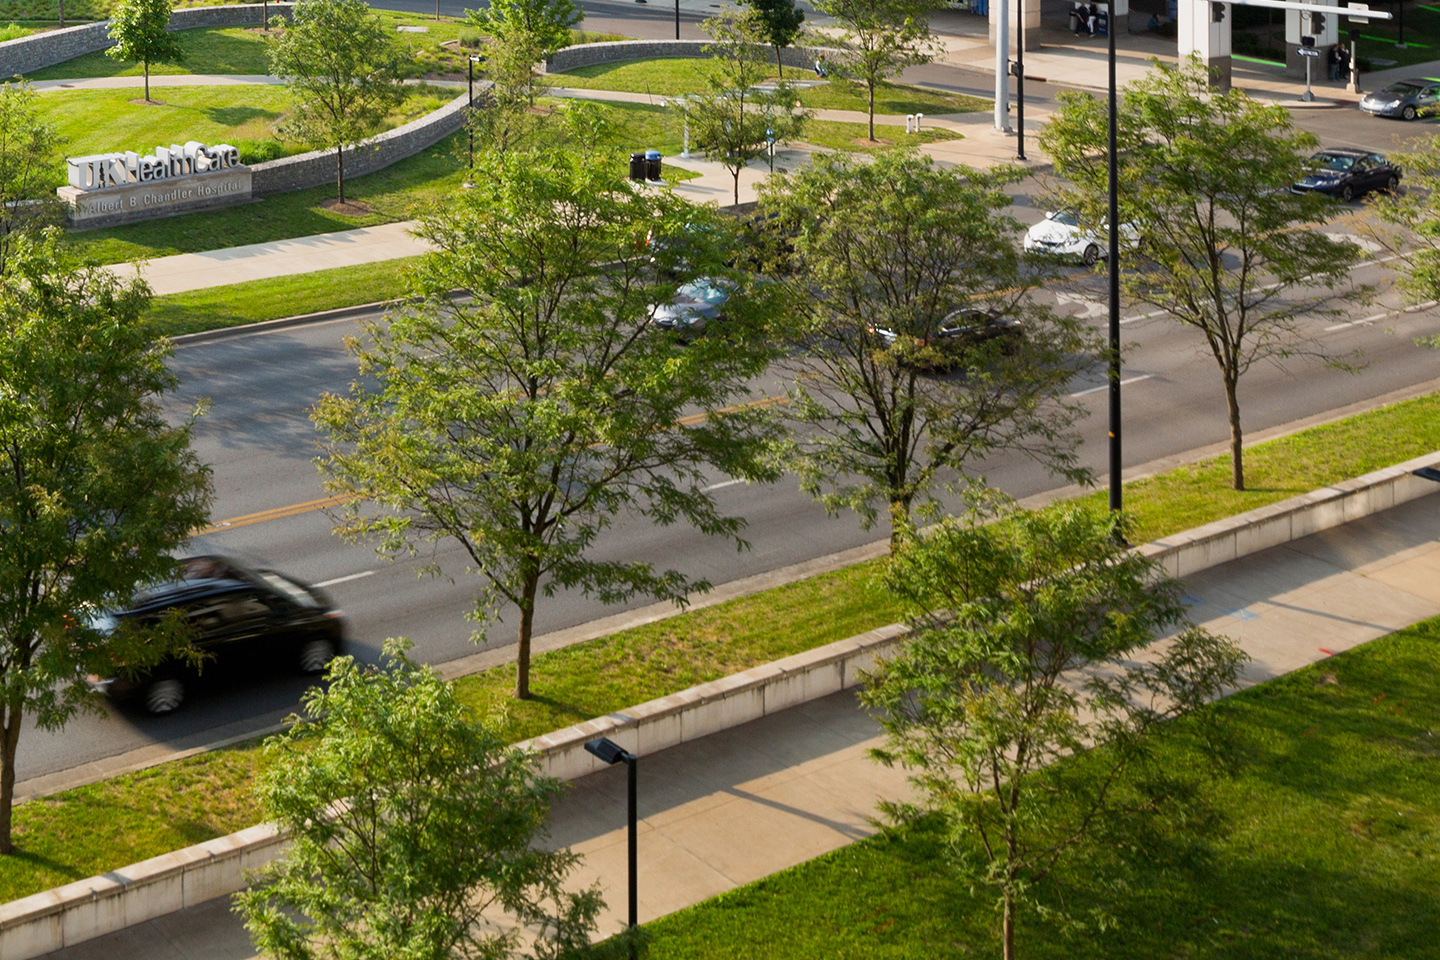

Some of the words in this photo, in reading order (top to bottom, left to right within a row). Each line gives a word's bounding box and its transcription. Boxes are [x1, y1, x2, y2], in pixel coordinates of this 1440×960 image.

[71, 156, 125, 189] UK
[125, 141, 240, 183] HealthCare
[87, 199, 124, 215] Albert
[129, 196, 140, 208] B.
[144, 188, 193, 205] Chandler
[197, 180, 242, 197] Hospital
